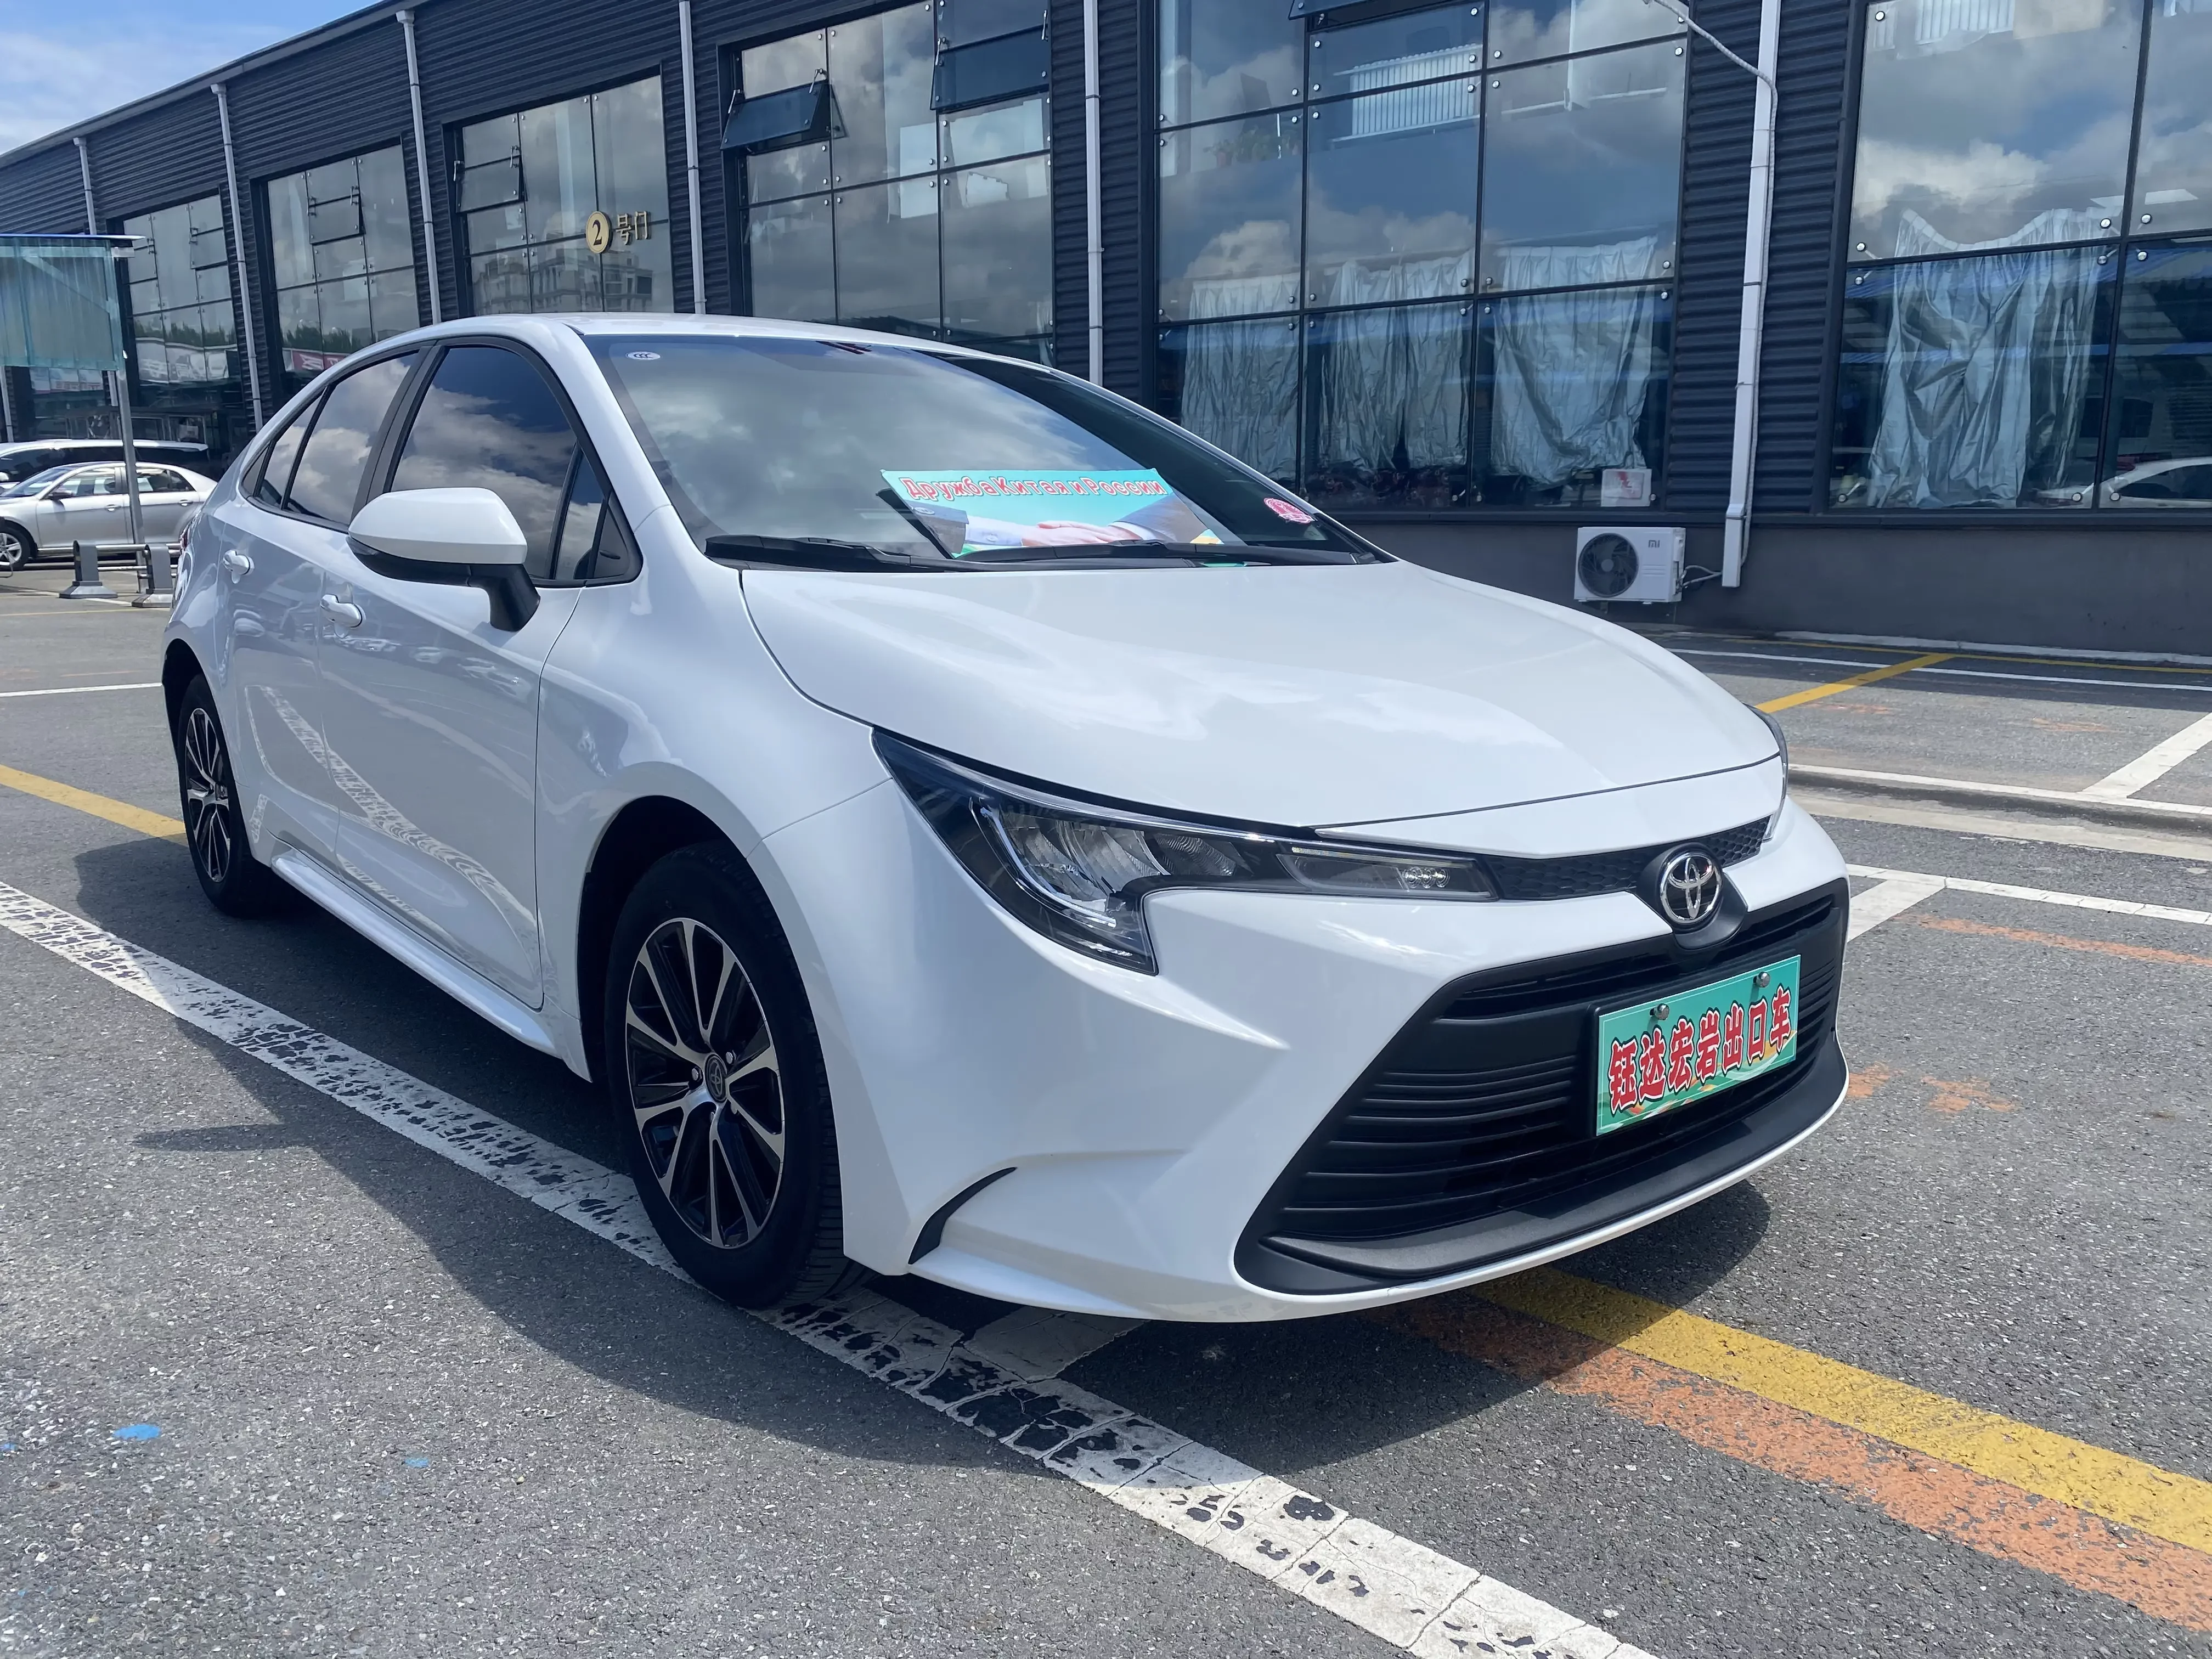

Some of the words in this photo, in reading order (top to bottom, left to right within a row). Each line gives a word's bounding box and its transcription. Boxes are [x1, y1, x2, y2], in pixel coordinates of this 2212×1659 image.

[899, 476, 1000, 501] Дружба
[989, 476, 1071, 495] Китая
[1079, 477, 1168, 496] России
